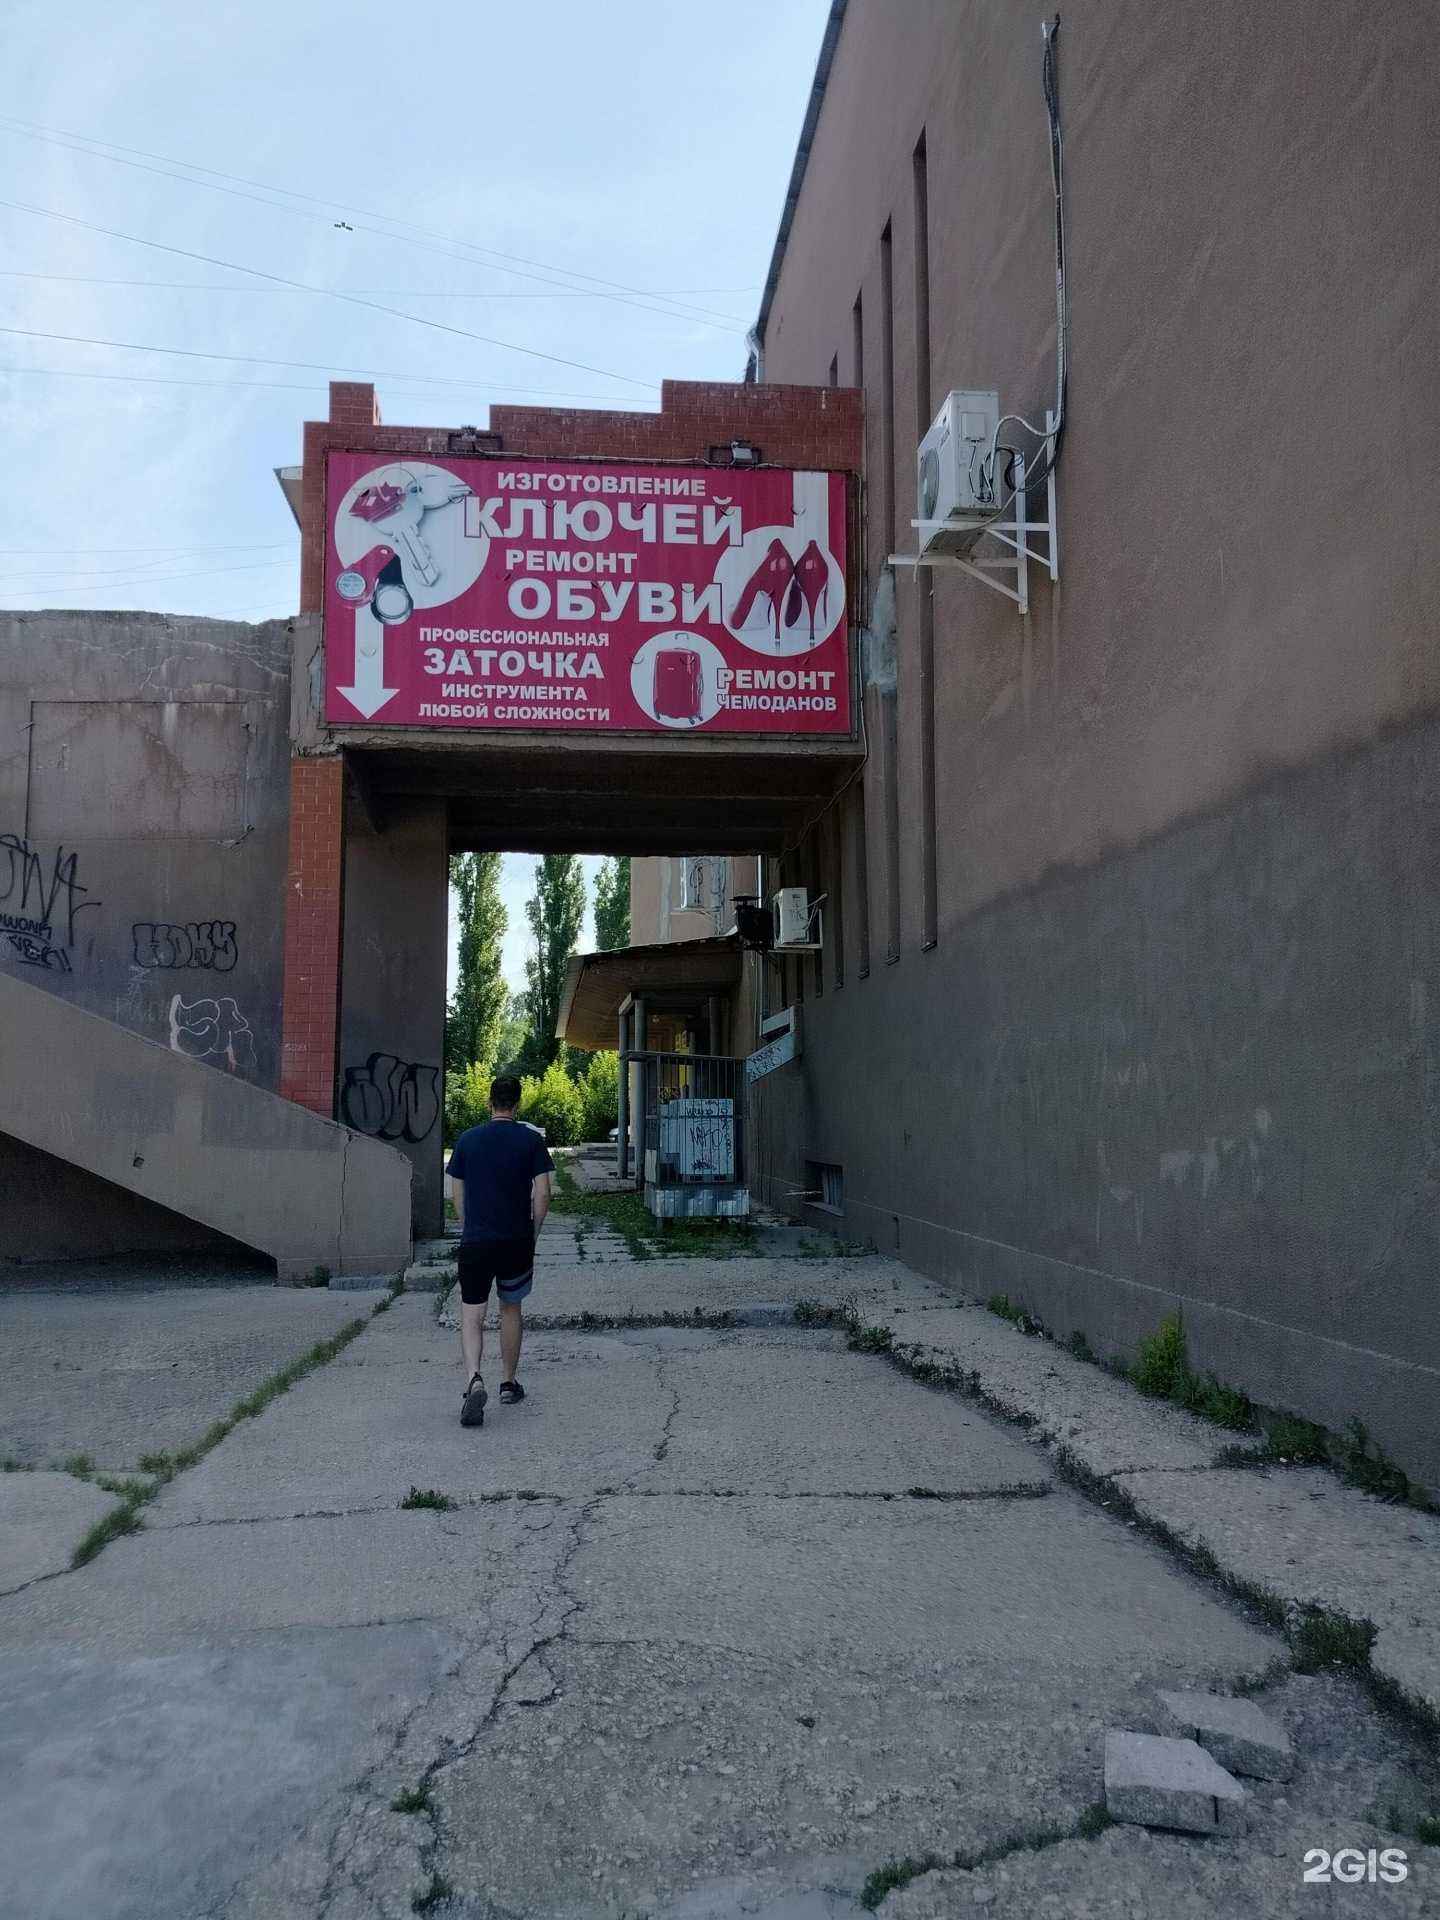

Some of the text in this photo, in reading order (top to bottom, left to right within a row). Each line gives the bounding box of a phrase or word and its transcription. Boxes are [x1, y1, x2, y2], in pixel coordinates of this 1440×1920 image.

[497, 472, 706, 497] ИЗГОТОВЛЕНИЕ
[464, 496, 743, 547] КЛЮЧЕЙ
[505, 549, 638, 574] РЕМОНТ
[507, 577, 723, 625] ОБУВИ
[419, 627, 610, 647] ПРОФЕССИОНАЛЬНАЯ
[423, 648, 605, 679] ЗАТОЧКА
[717, 668, 836, 691] РЕМОНТ
[441, 683, 588, 701] ИНСТРУМЕНТА
[717, 694, 837, 713] ЧЕМОДАНОВ
[418, 702, 610, 721] ЛЮБОЙ СЛОЖНОСТИ
